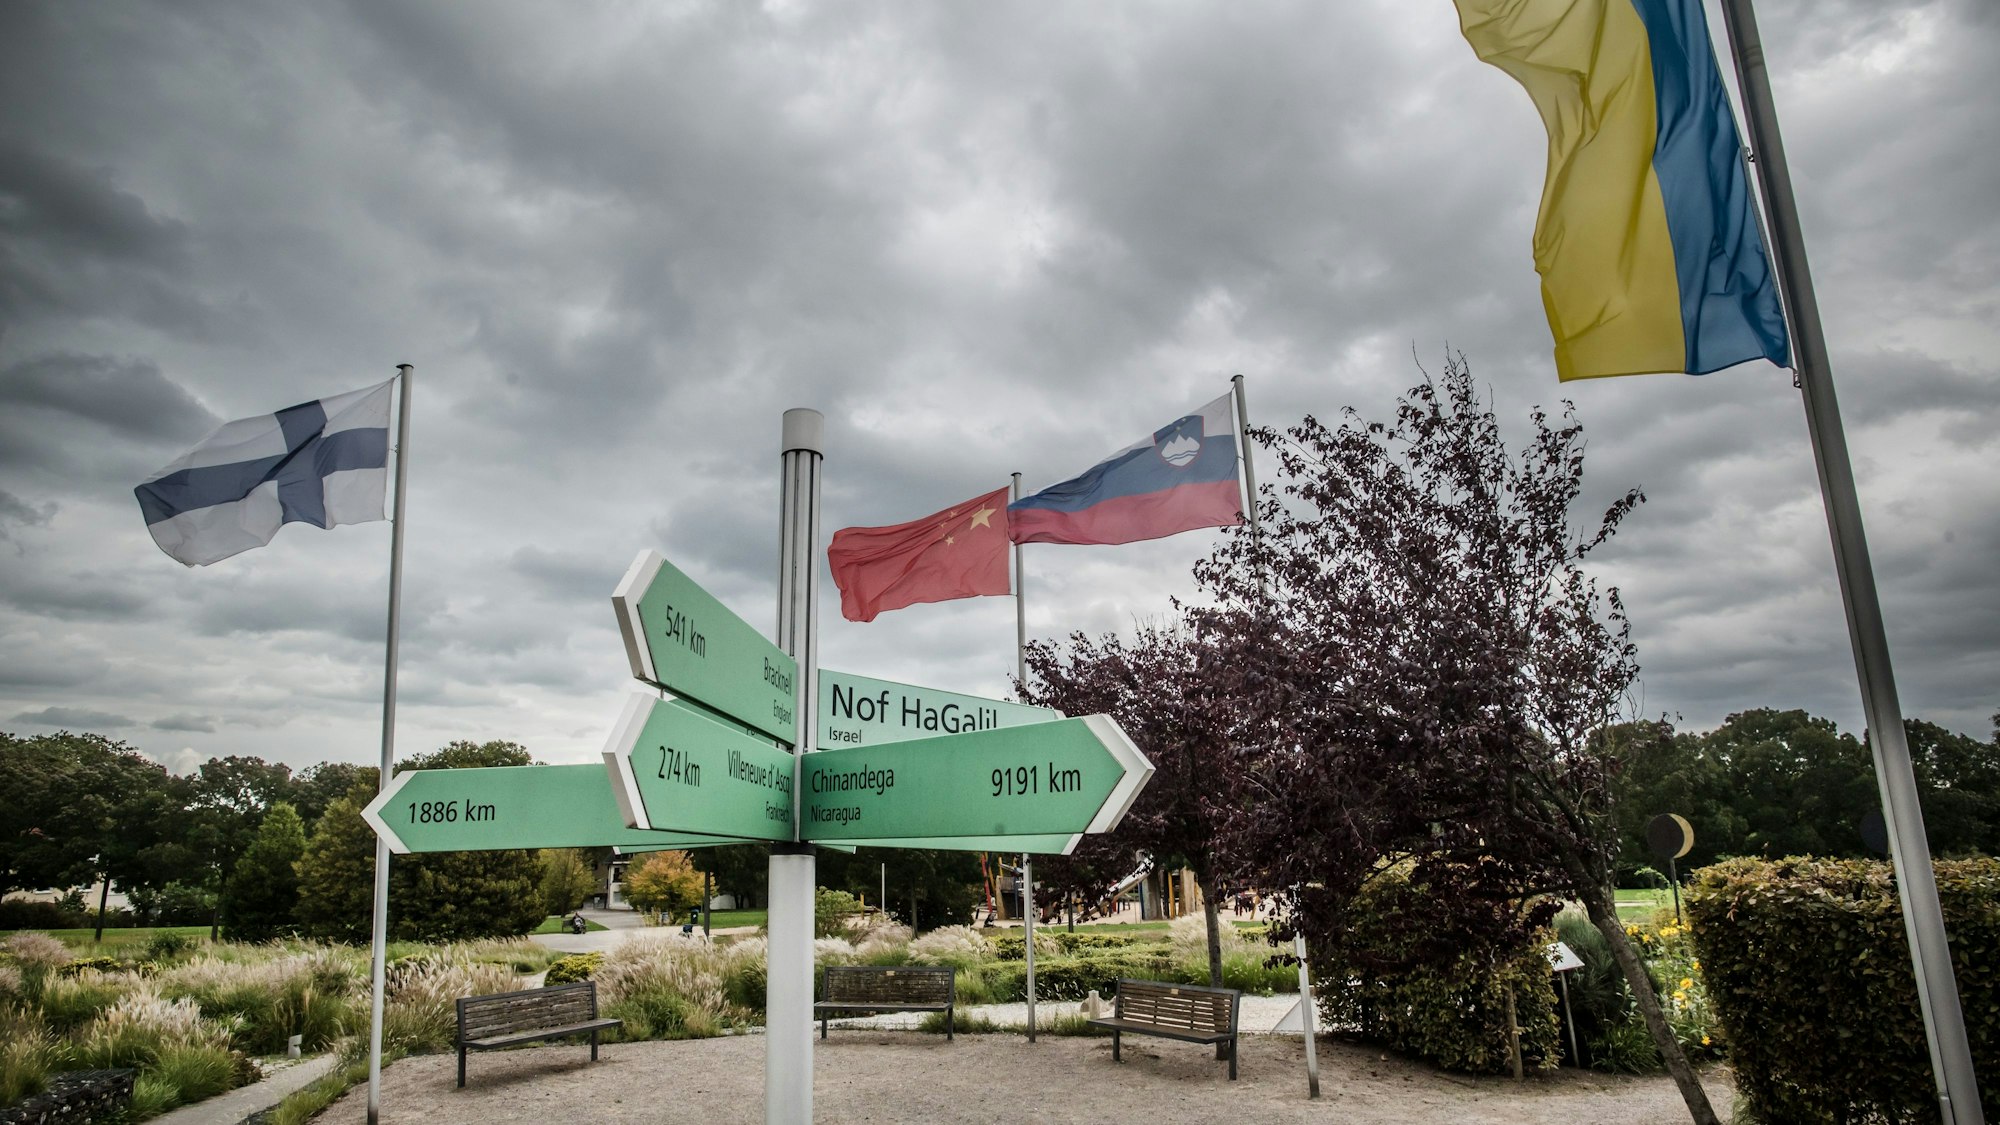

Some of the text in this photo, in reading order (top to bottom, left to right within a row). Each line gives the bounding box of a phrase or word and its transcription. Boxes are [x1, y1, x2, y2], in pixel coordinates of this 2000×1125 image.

[665, 604, 706, 658] 541 km
[764, 656, 792, 697] Bracknell
[773, 699, 792, 725] England
[831, 684, 997, 734] Nof HaGalil
[829, 726, 862, 744] Israel
[658, 746, 700, 788] 274 km
[727, 748, 766, 787] Villeneuve
[812, 764, 895, 796] Chinandega
[991, 762, 1081, 797] 9191 km
[408, 799, 495, 824] 1886 km
[766, 801, 789, 823] Frankreich
[811, 804, 861, 825] Nicaragua
